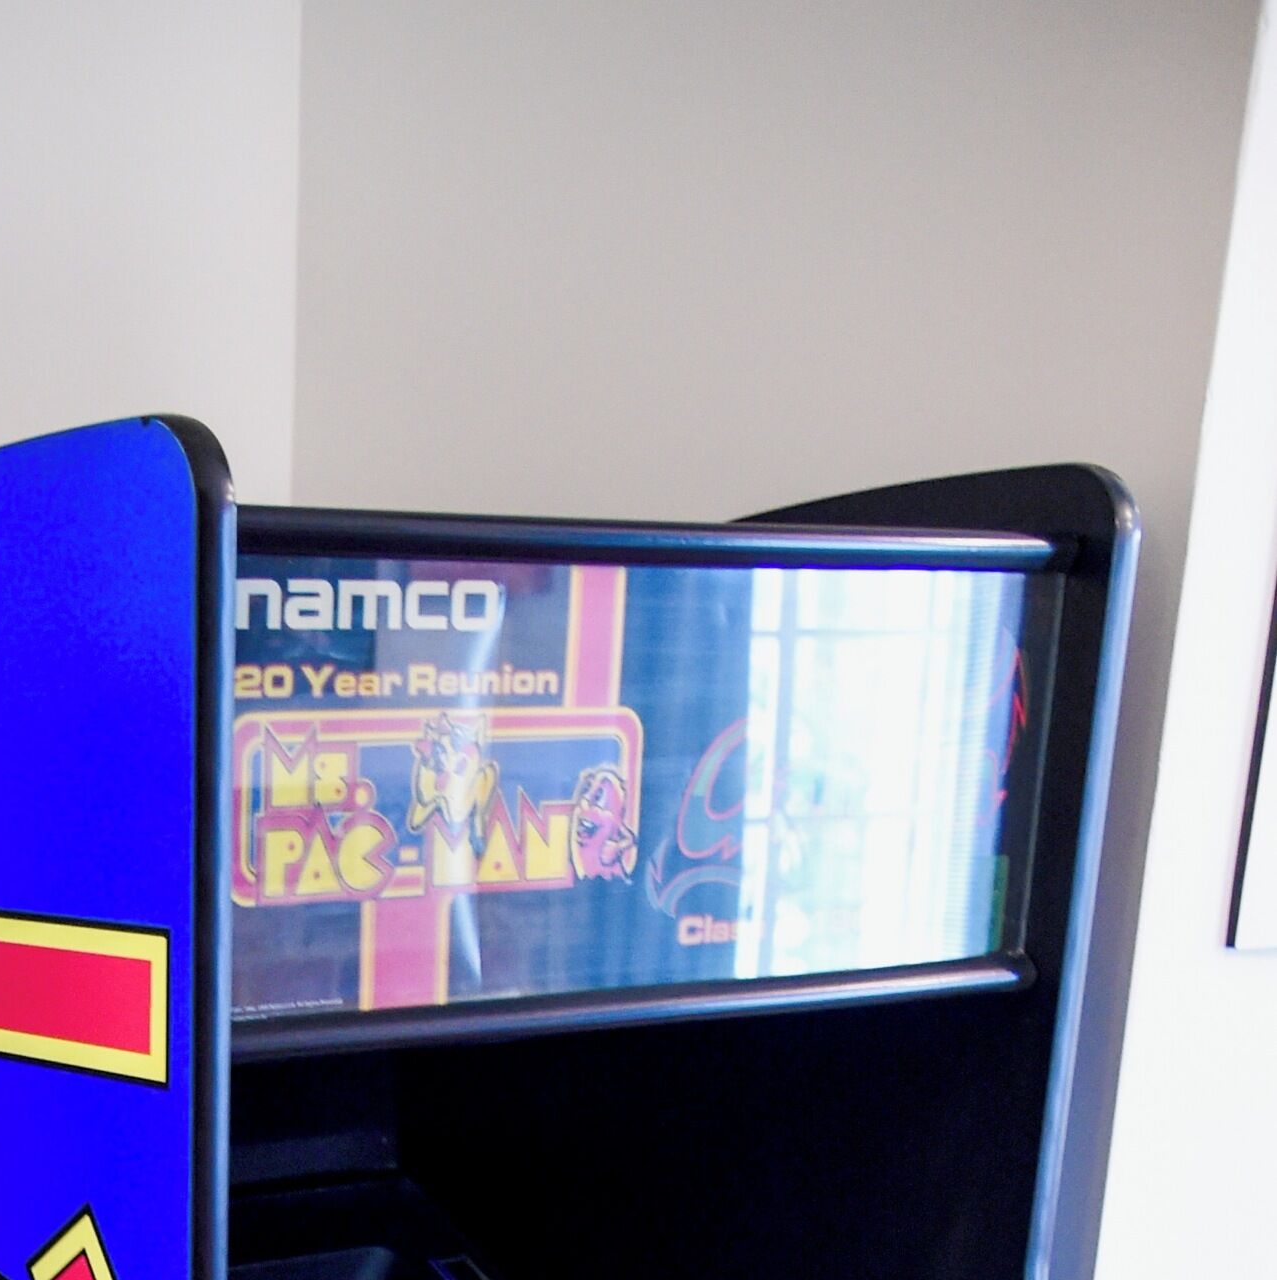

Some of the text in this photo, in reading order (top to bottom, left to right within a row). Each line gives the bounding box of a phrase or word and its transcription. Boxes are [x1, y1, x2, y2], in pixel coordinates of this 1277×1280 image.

[234, 578, 501, 632] namco
[233, 664, 559, 699] 20 Year Reunion
